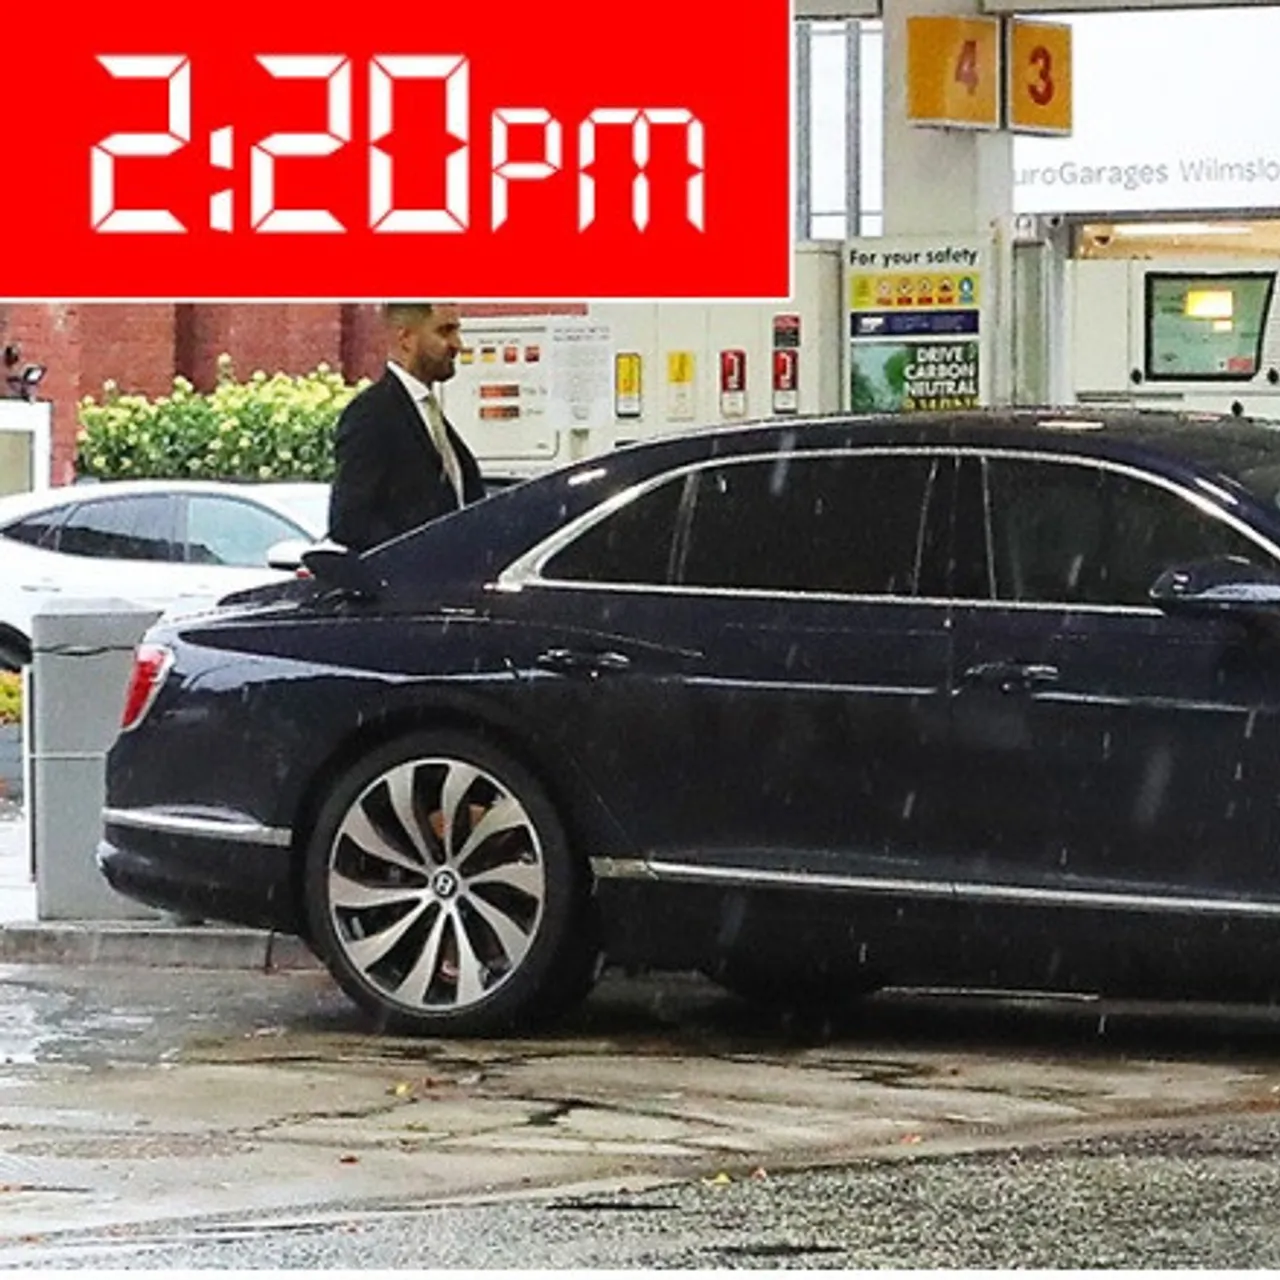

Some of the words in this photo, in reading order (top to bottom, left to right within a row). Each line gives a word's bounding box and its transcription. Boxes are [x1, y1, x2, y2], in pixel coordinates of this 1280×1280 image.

[954, 40, 979, 95] 4
[1028, 46, 1054, 106] 3
[1013, 161, 1168, 190] uroGarages
[850, 250, 875, 265] For
[884, 251, 918, 267] your
[927, 248, 977, 265] safety
[917, 346, 962, 362] DRIVE
[904, 364, 974, 378] CARBON
[905, 382, 975, 396] NEUTRAL
